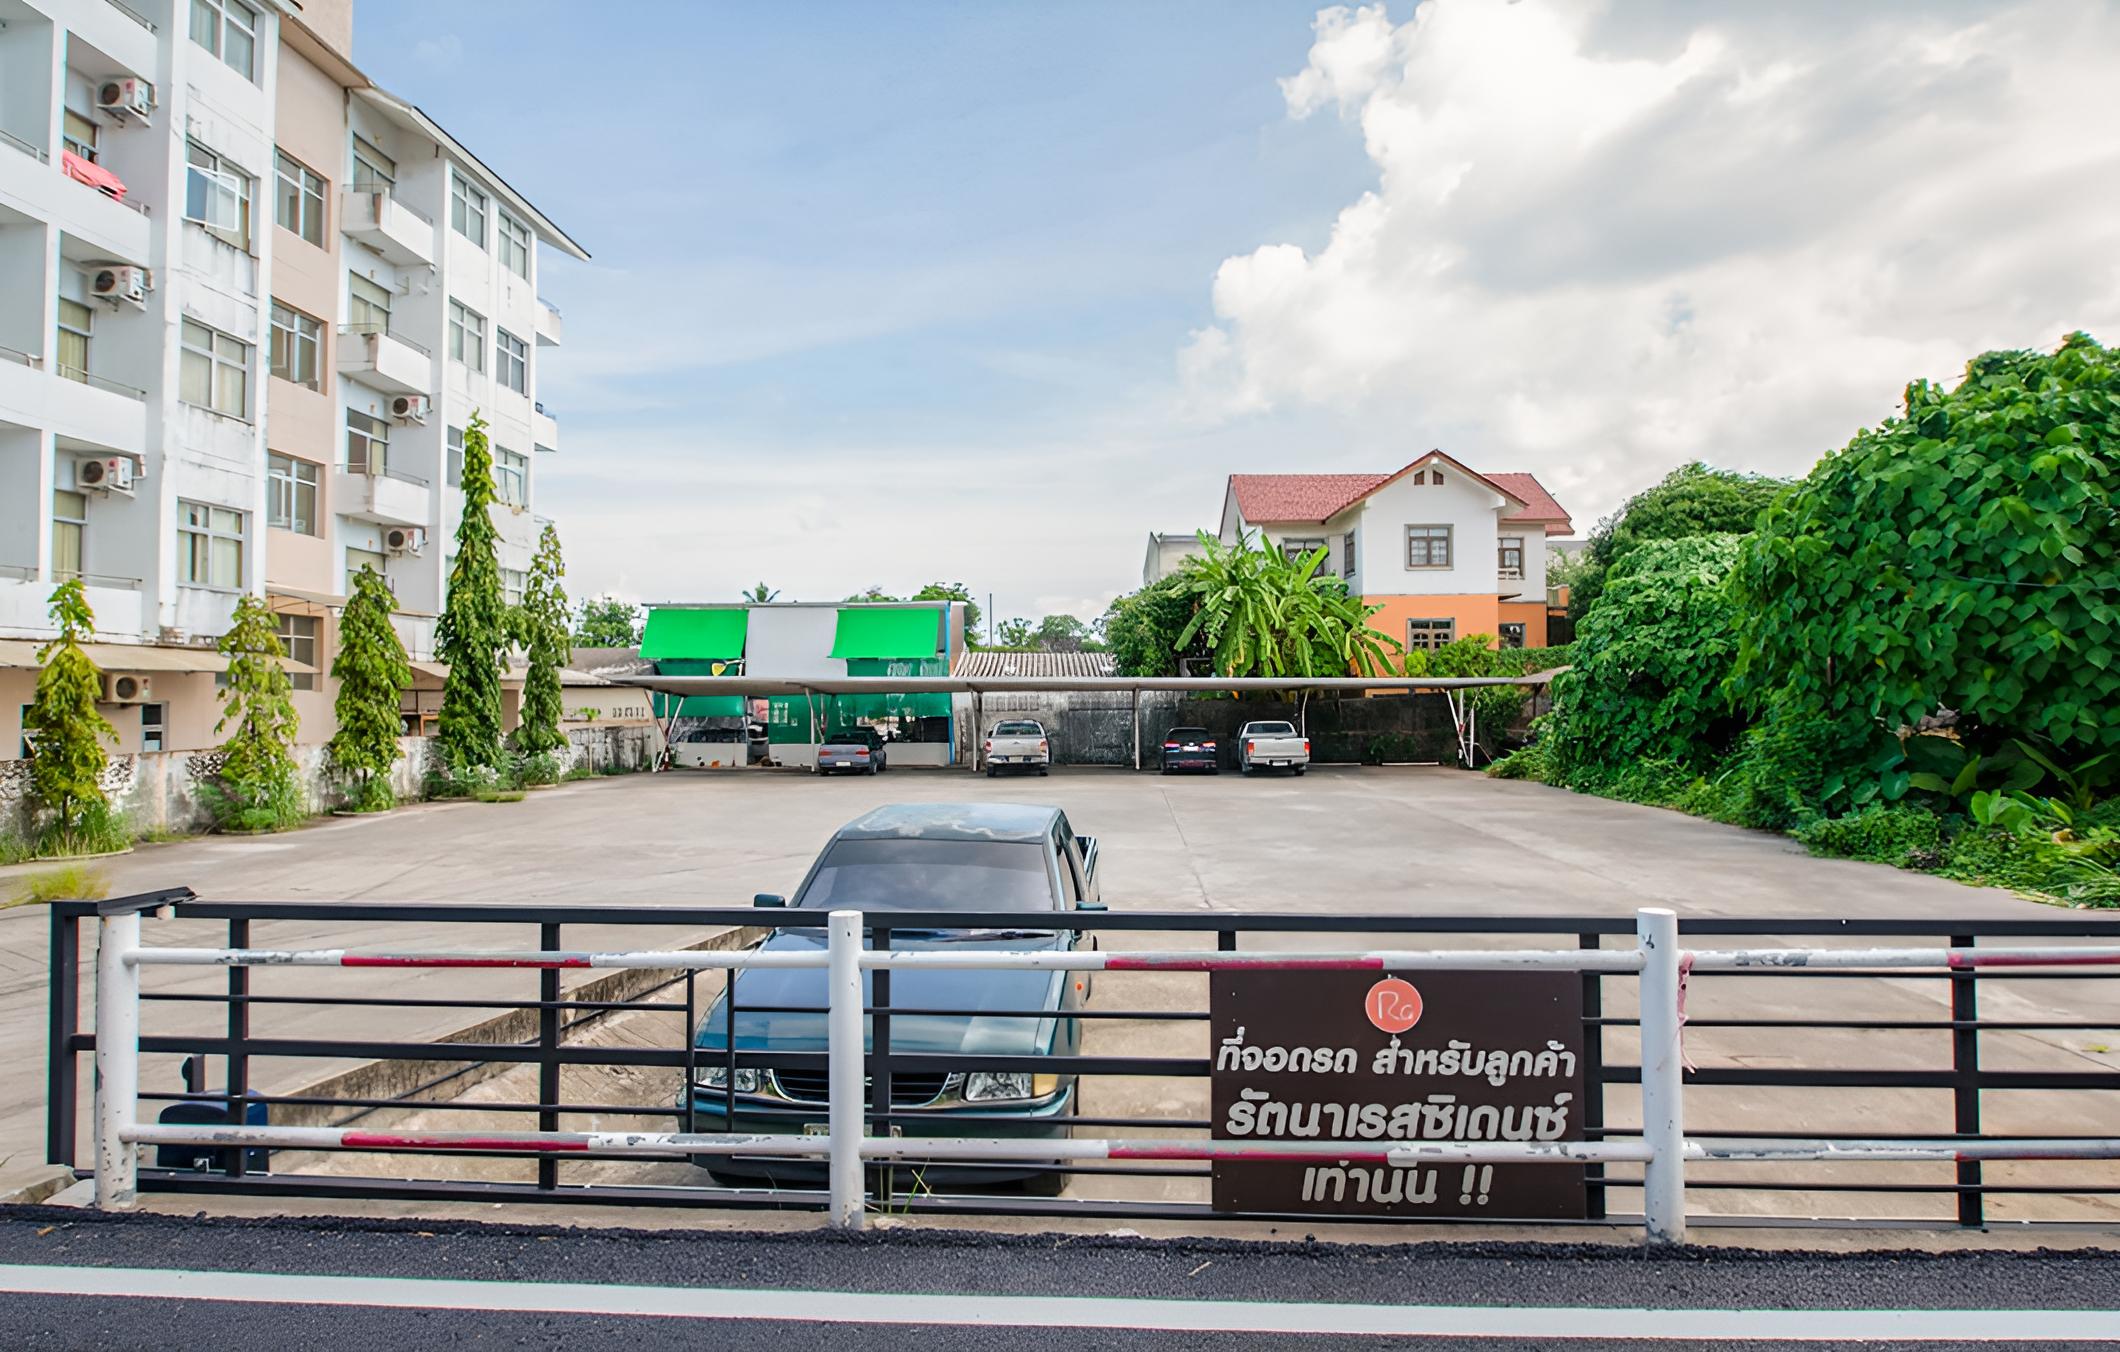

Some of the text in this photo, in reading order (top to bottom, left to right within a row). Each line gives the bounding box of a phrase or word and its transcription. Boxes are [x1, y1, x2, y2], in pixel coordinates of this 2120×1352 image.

[1216, 1026, 1576, 1087] ที่จอดรถ สำหรับลูกค้า
[1226, 1087, 1573, 1141] รัตนาเรสซิเดนซ์
[1302, 1158, 1438, 1204] เทานน
